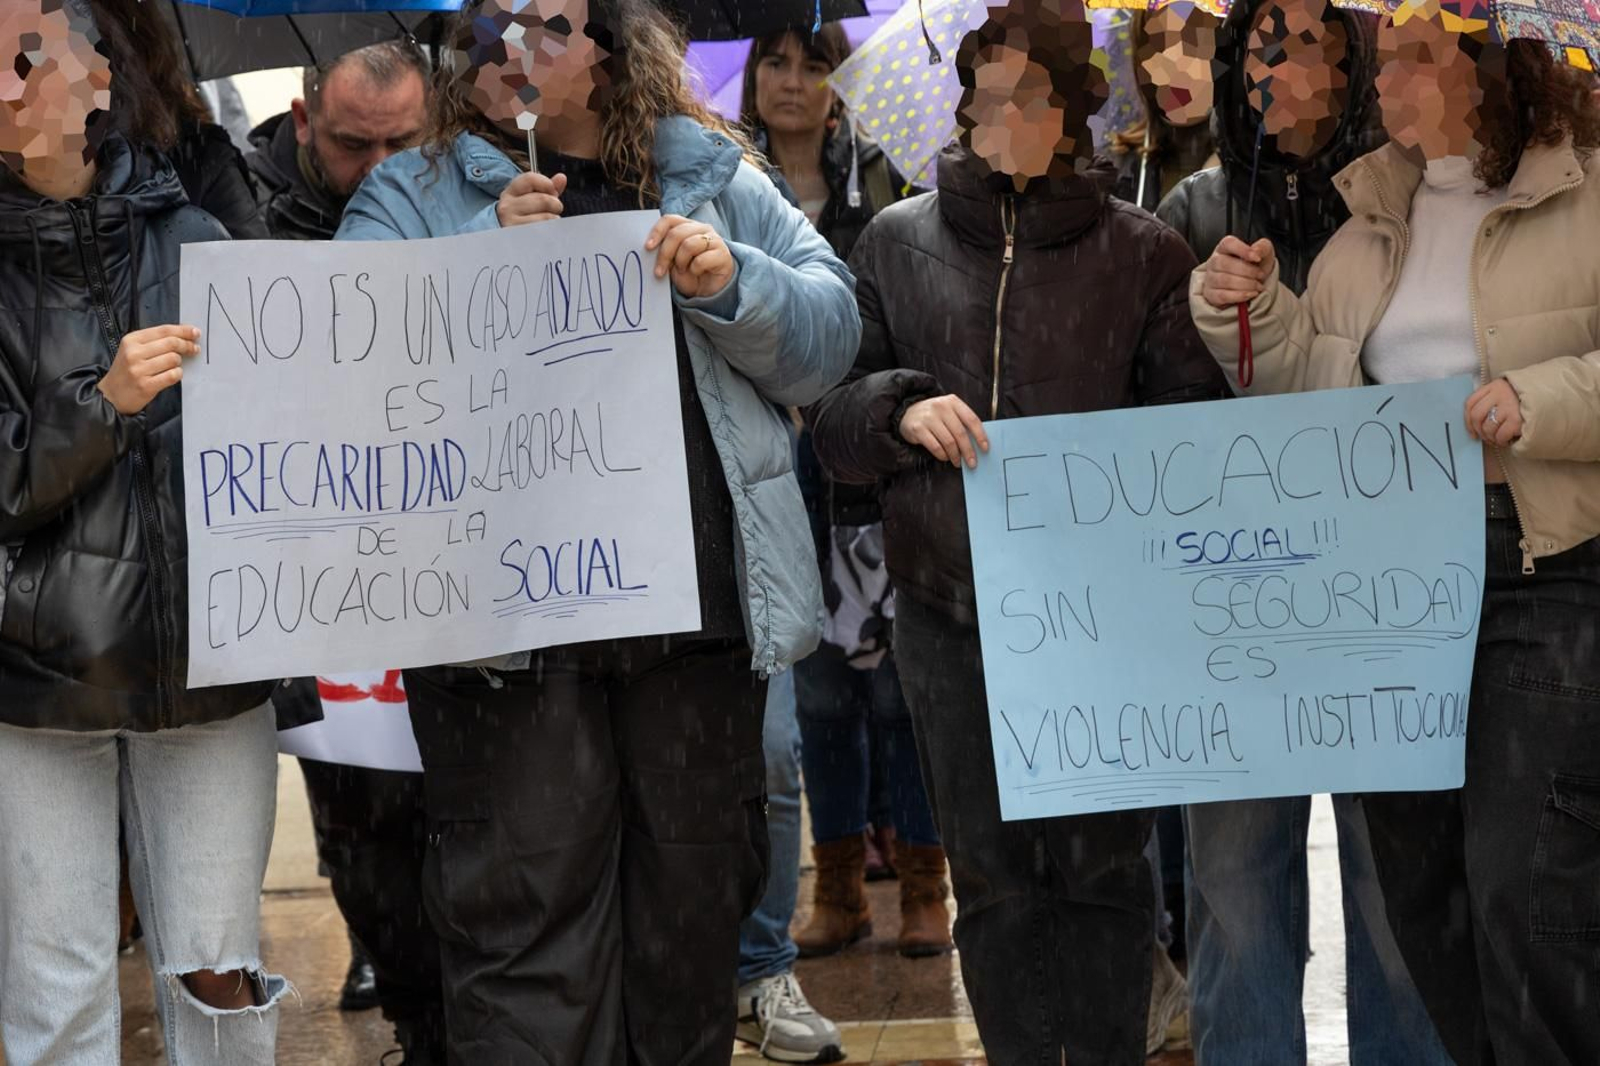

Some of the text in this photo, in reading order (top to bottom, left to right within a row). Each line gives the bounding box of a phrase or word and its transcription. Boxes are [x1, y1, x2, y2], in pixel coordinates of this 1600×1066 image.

[206, 250, 643, 365] NO ES UN CASO AISLADO
[385, 368, 508, 432] ES LA
[200, 401, 642, 527] PRECARIEDAD LABORAL
[1003, 396, 1459, 532] EDUCACIÓN
[357, 510, 486, 556] DE LA
[207, 538, 648, 649] EDUCACIÓN SOCIAL
[1001, 562, 1479, 653] SIN SEGURIDAD
[1206, 645, 1276, 681] ES
